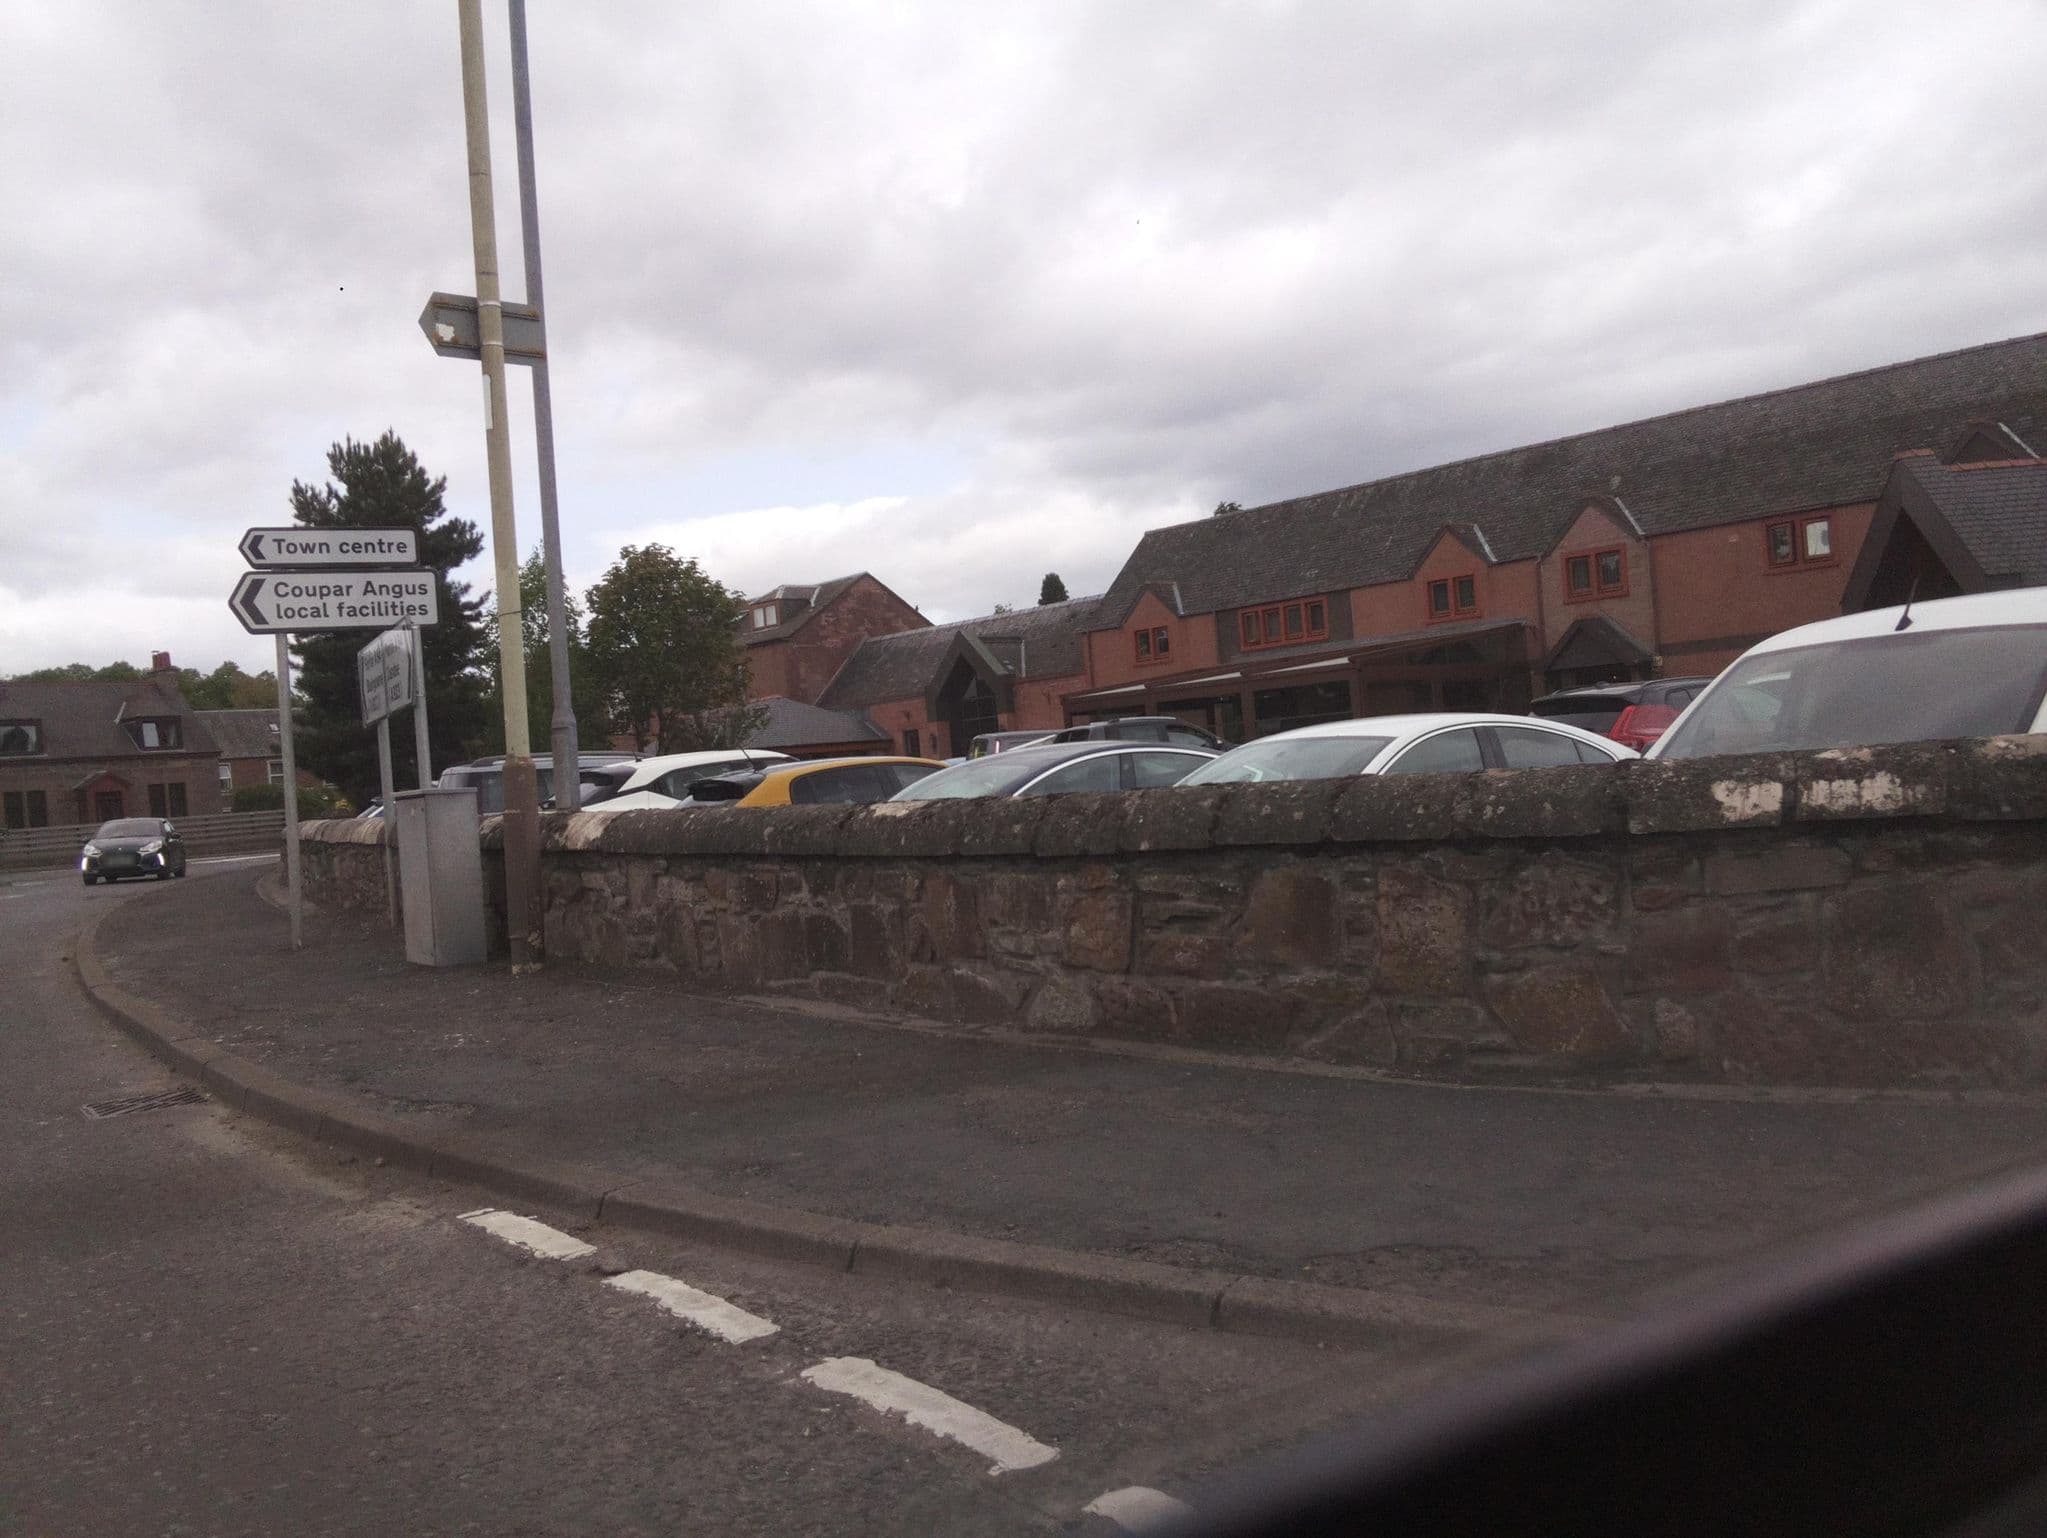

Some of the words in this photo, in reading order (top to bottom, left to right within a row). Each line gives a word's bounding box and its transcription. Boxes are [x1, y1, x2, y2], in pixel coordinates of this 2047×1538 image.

[272, 538, 331, 554] Town
[339, 538, 408, 554] centre
[274, 581, 353, 600] Coupar
[362, 580, 428, 599] Angus
[276, 602, 329, 619] local
[336, 601, 429, 618] facilities
